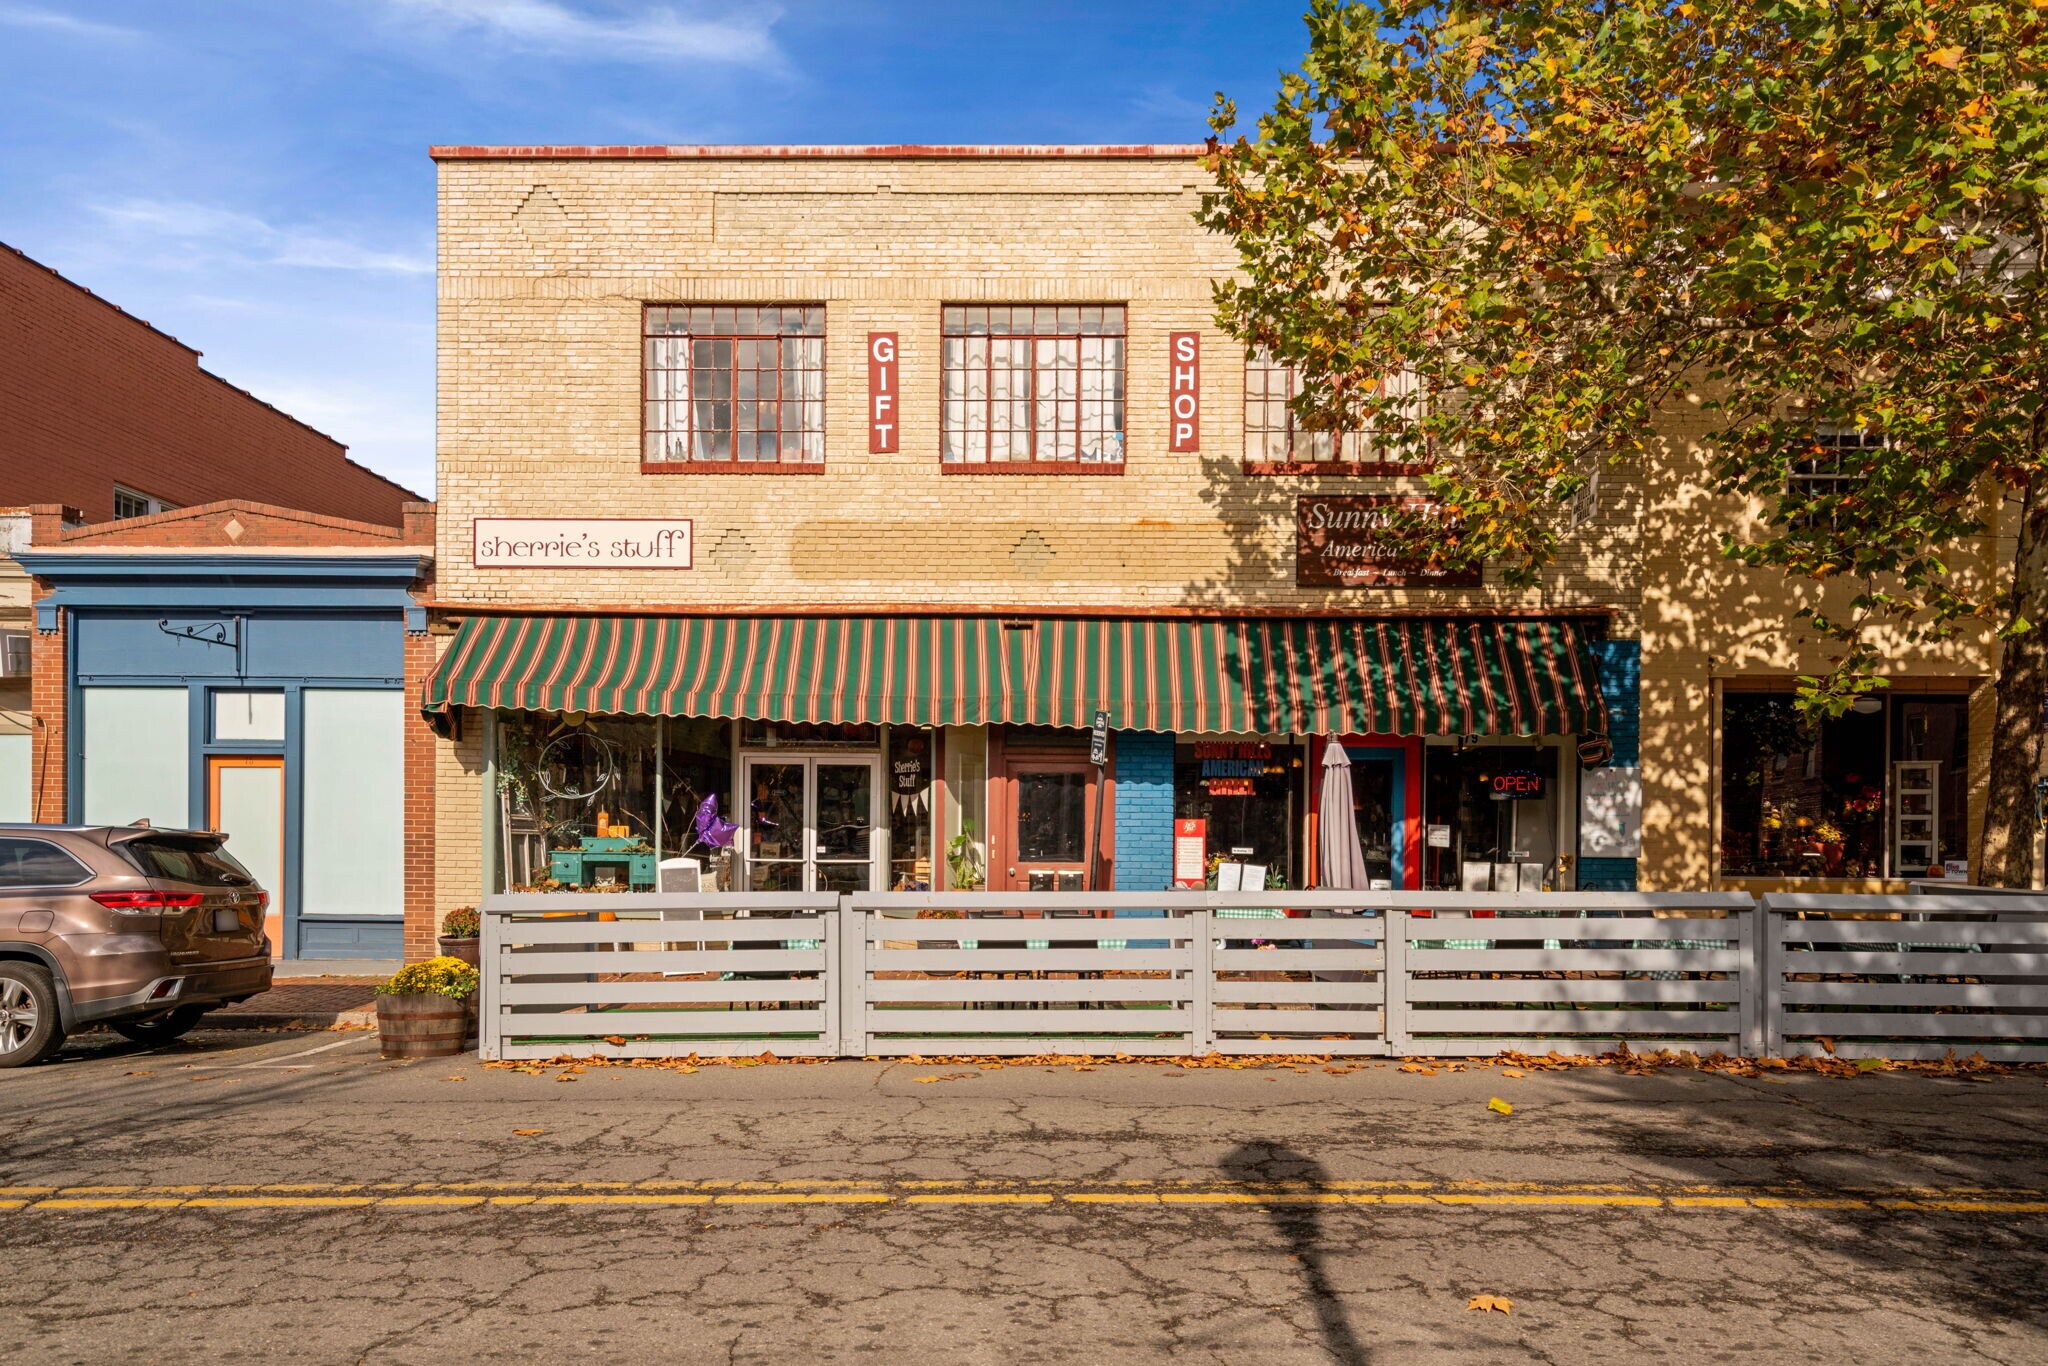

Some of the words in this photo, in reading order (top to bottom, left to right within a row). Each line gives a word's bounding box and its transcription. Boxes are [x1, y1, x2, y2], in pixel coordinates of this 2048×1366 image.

[873, 337, 894, 448] GIFT
[1174, 336, 1196, 447] SHOP
[481, 533, 601, 558] sherrie's
[610, 529, 685, 558] stuff
[1321, 540, 1403, 557] America
[1333, 568, 1370, 578] Breakfast
[1382, 568, 1407, 577] Lunch
[1419, 568, 1447, 577] Dinner
[1194, 741, 1235, 759] SUNNY
[894, 760, 920, 773] Sherrie's
[1201, 760, 1265, 777] AMERICAN
[899, 774, 915, 787] Stuff
[1493, 775, 1539, 791] OPEN
